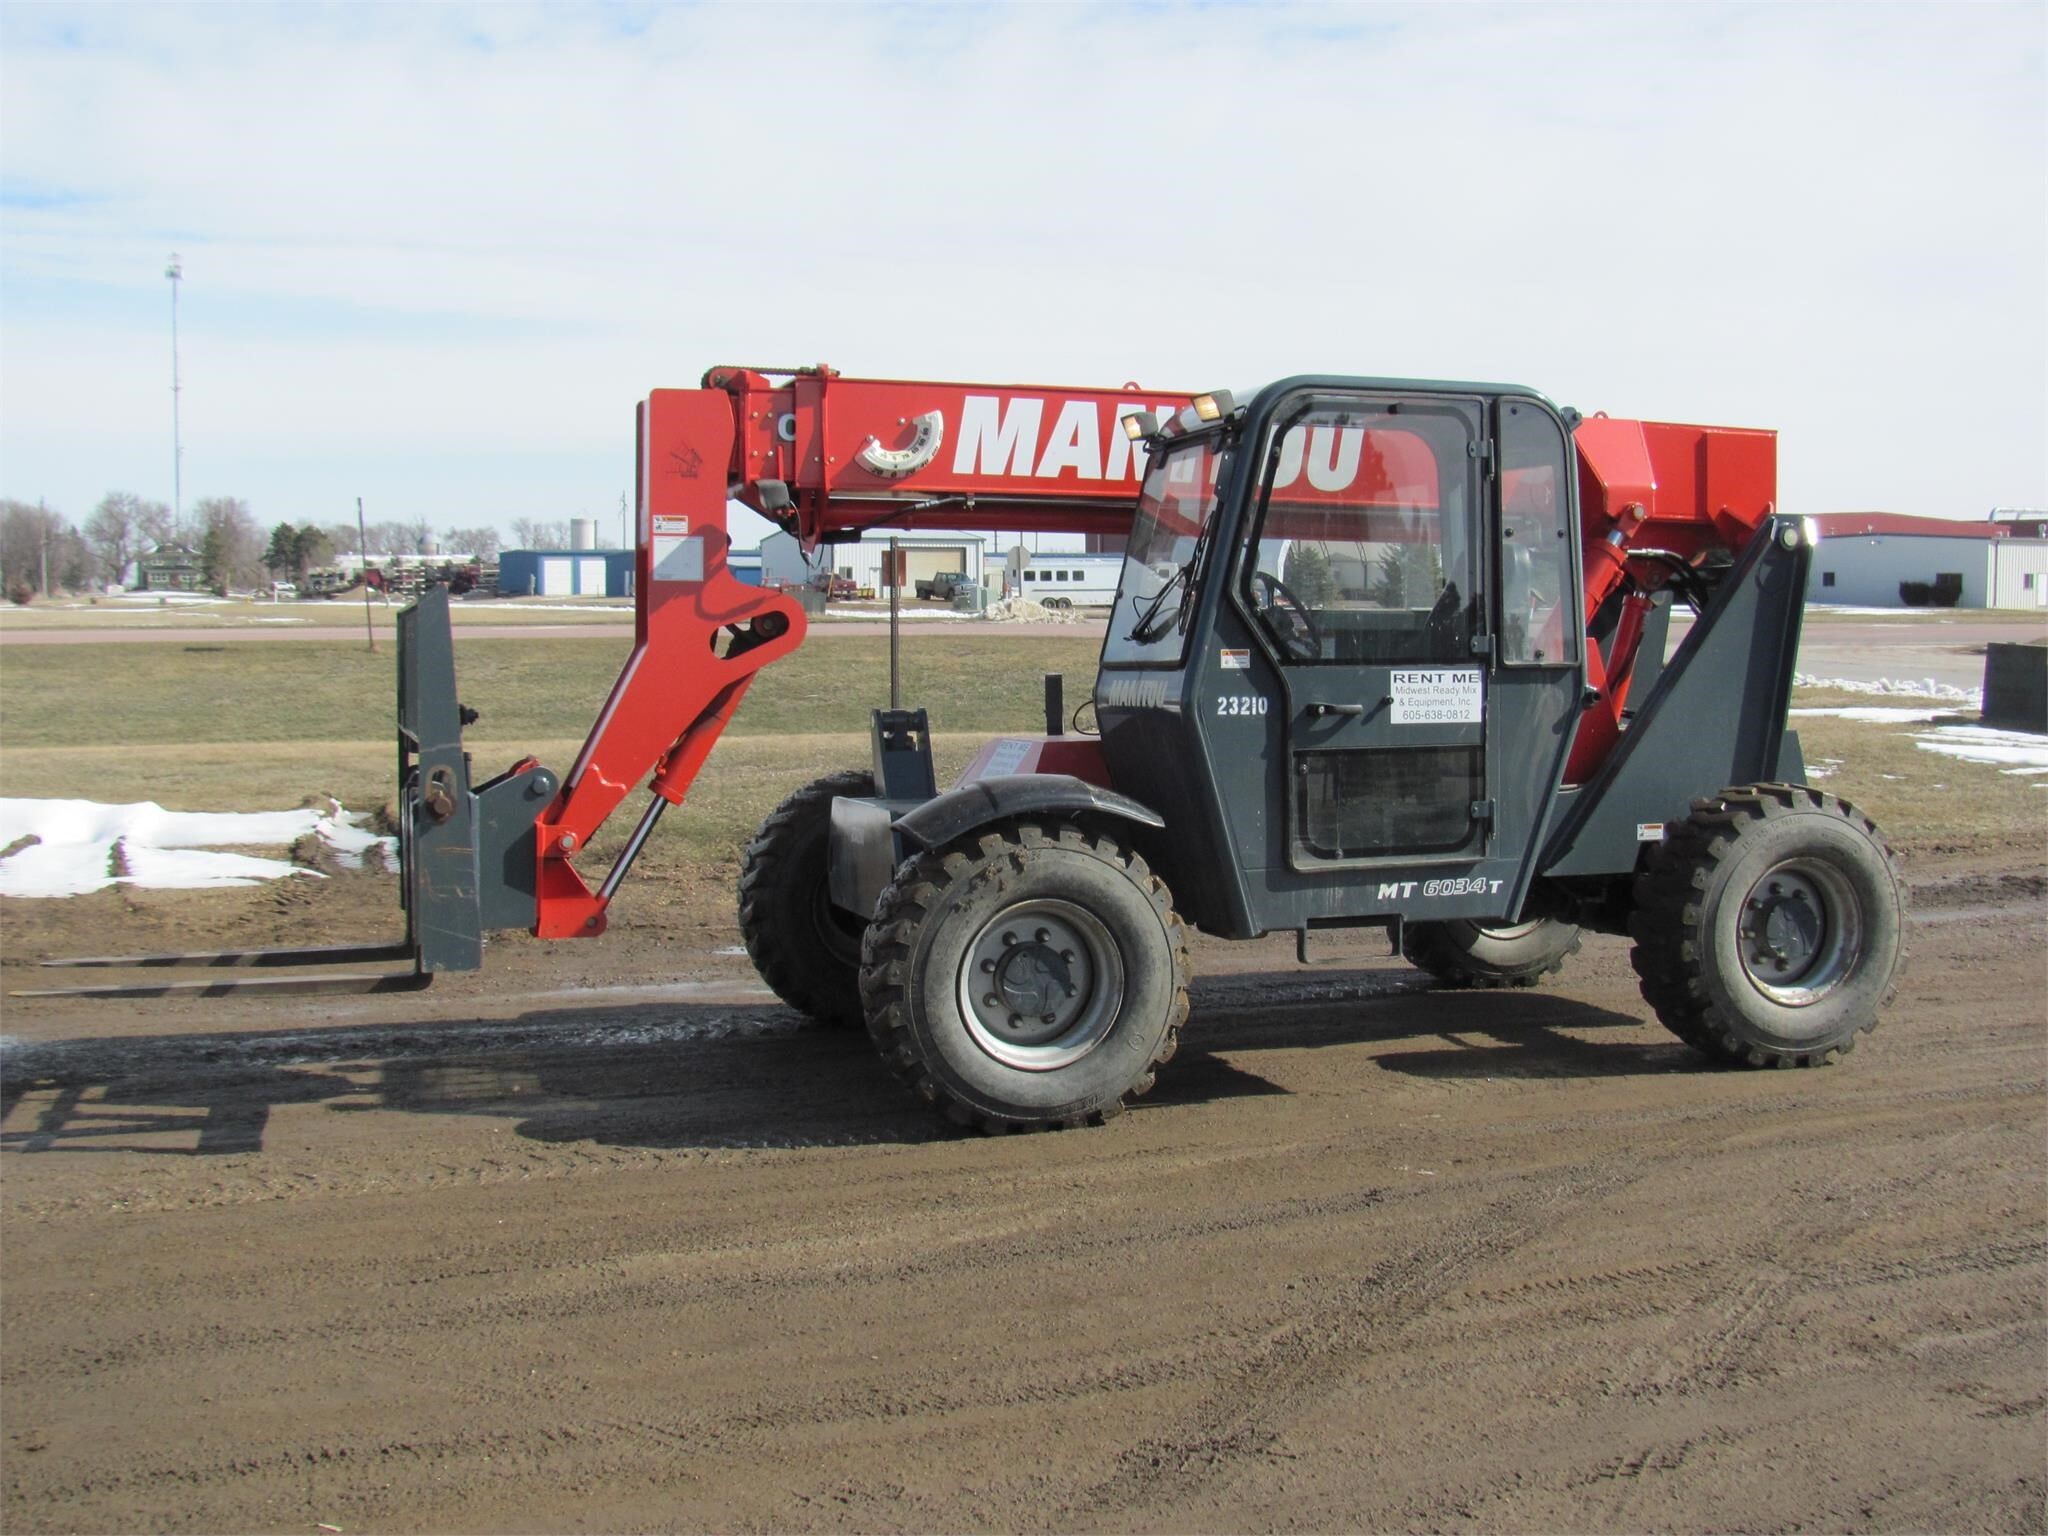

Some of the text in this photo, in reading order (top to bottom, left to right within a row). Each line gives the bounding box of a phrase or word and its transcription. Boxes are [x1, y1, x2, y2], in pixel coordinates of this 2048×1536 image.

[1393, 673, 1480, 684] RENT ME
[1395, 686, 1477, 697] Midwest Ready Mix
[1217, 696, 1268, 715] 23210
[1403, 710, 1470, 720] 605-638-0812
[1377, 877, 1503, 900] MT 6034 T
